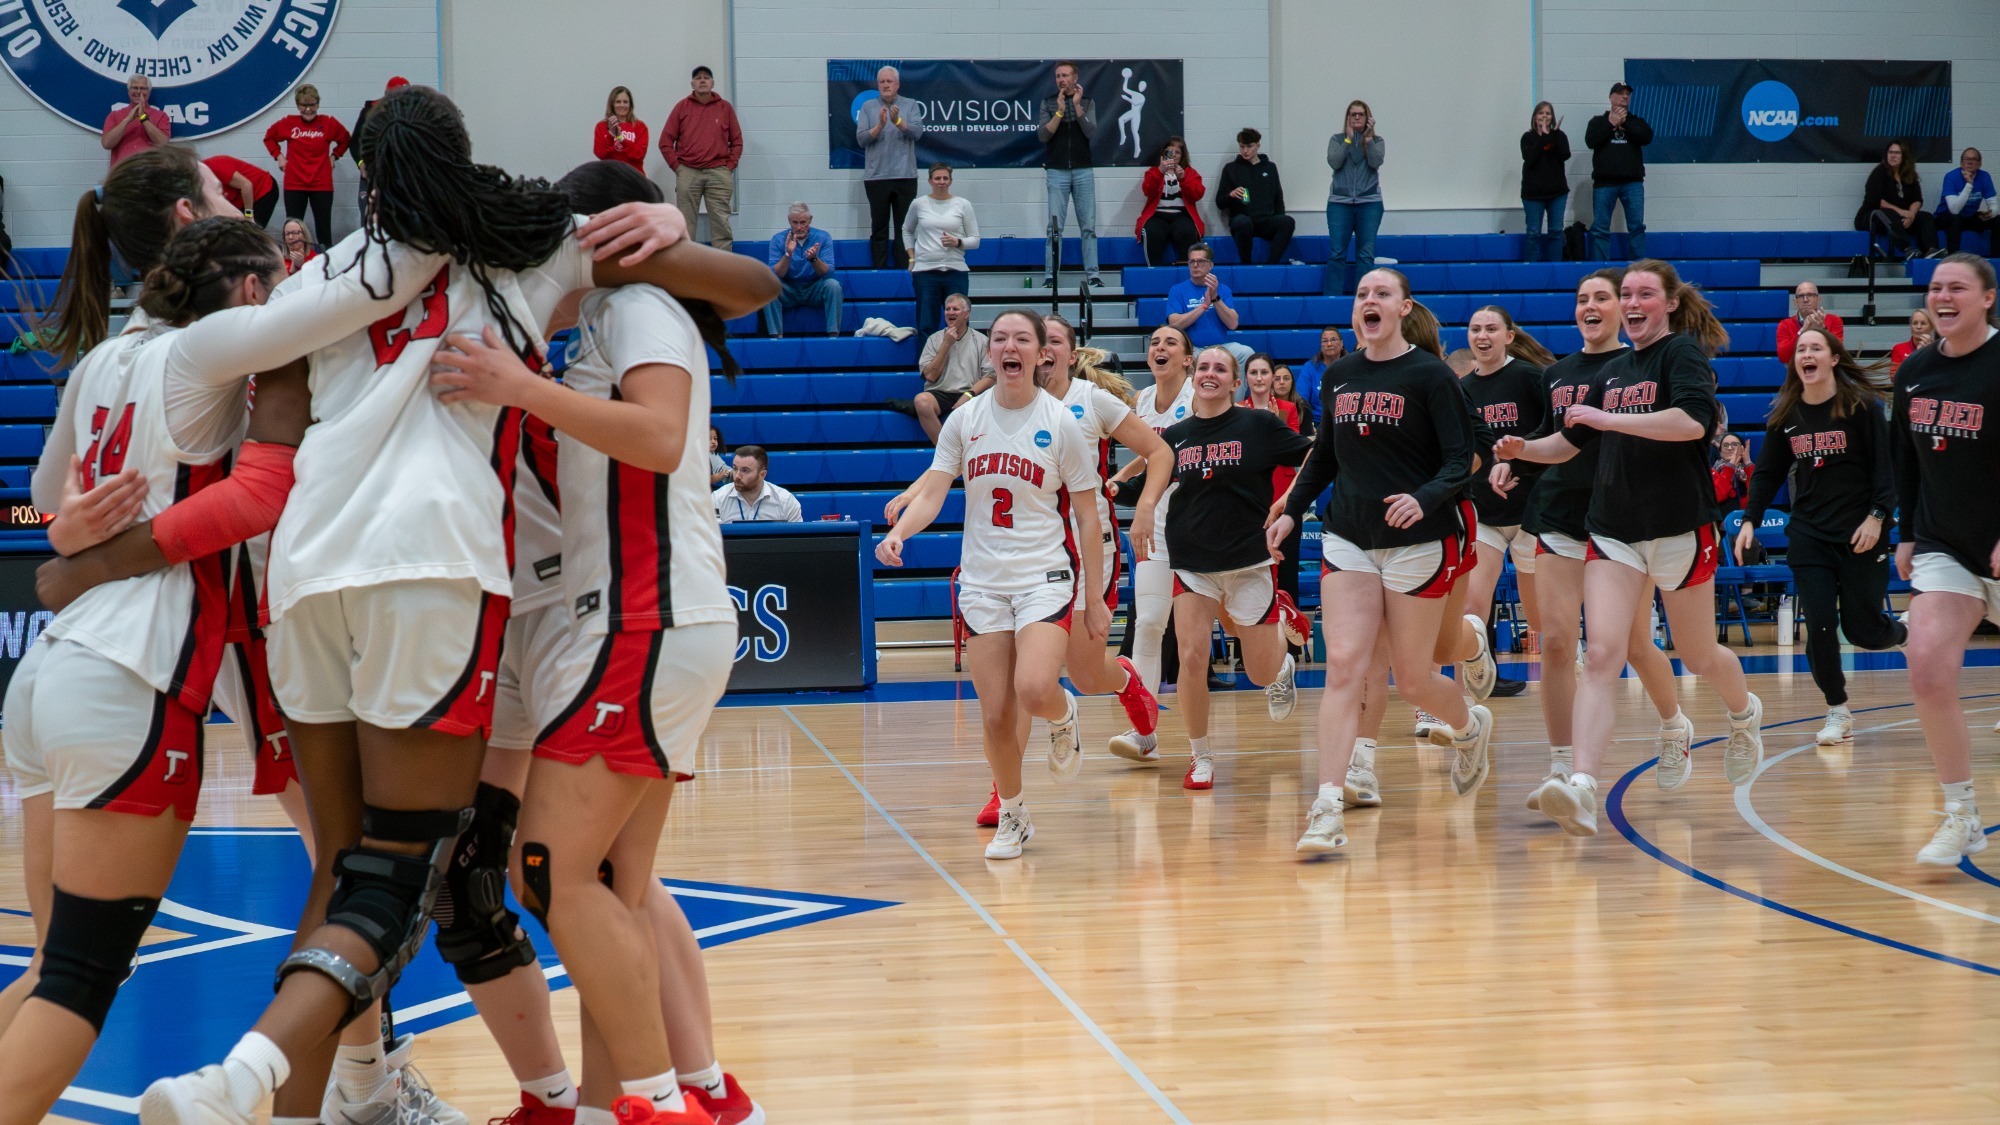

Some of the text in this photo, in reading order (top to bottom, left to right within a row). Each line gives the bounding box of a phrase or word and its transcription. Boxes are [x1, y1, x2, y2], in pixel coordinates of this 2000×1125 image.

[232, 4, 267, 40] WIN
[83, 38, 131, 73] HARD
[206, 33, 239, 64] DAY
[135, 55, 192, 78] CHEER
[291, 127, 324, 139] Denison
[966, 124, 1009, 132] DEVELOP
[1333, 391, 1405, 419] BIG RED
[1621, 381, 1657, 407] RED
[1335, 413, 1400, 426] BASKETBALL
[1484, 402, 1518, 423] RED
[1908, 397, 1984, 431] BIG RED
[1178, 441, 1242, 468] BIG RED
[1790, 431, 1847, 455] BIG RED
[967, 452, 1045, 489] DENISON
[1178, 459, 1240, 474] BASKETBALL
[11, 505, 41, 524] POSS
[992, 488, 1013, 528] 2
